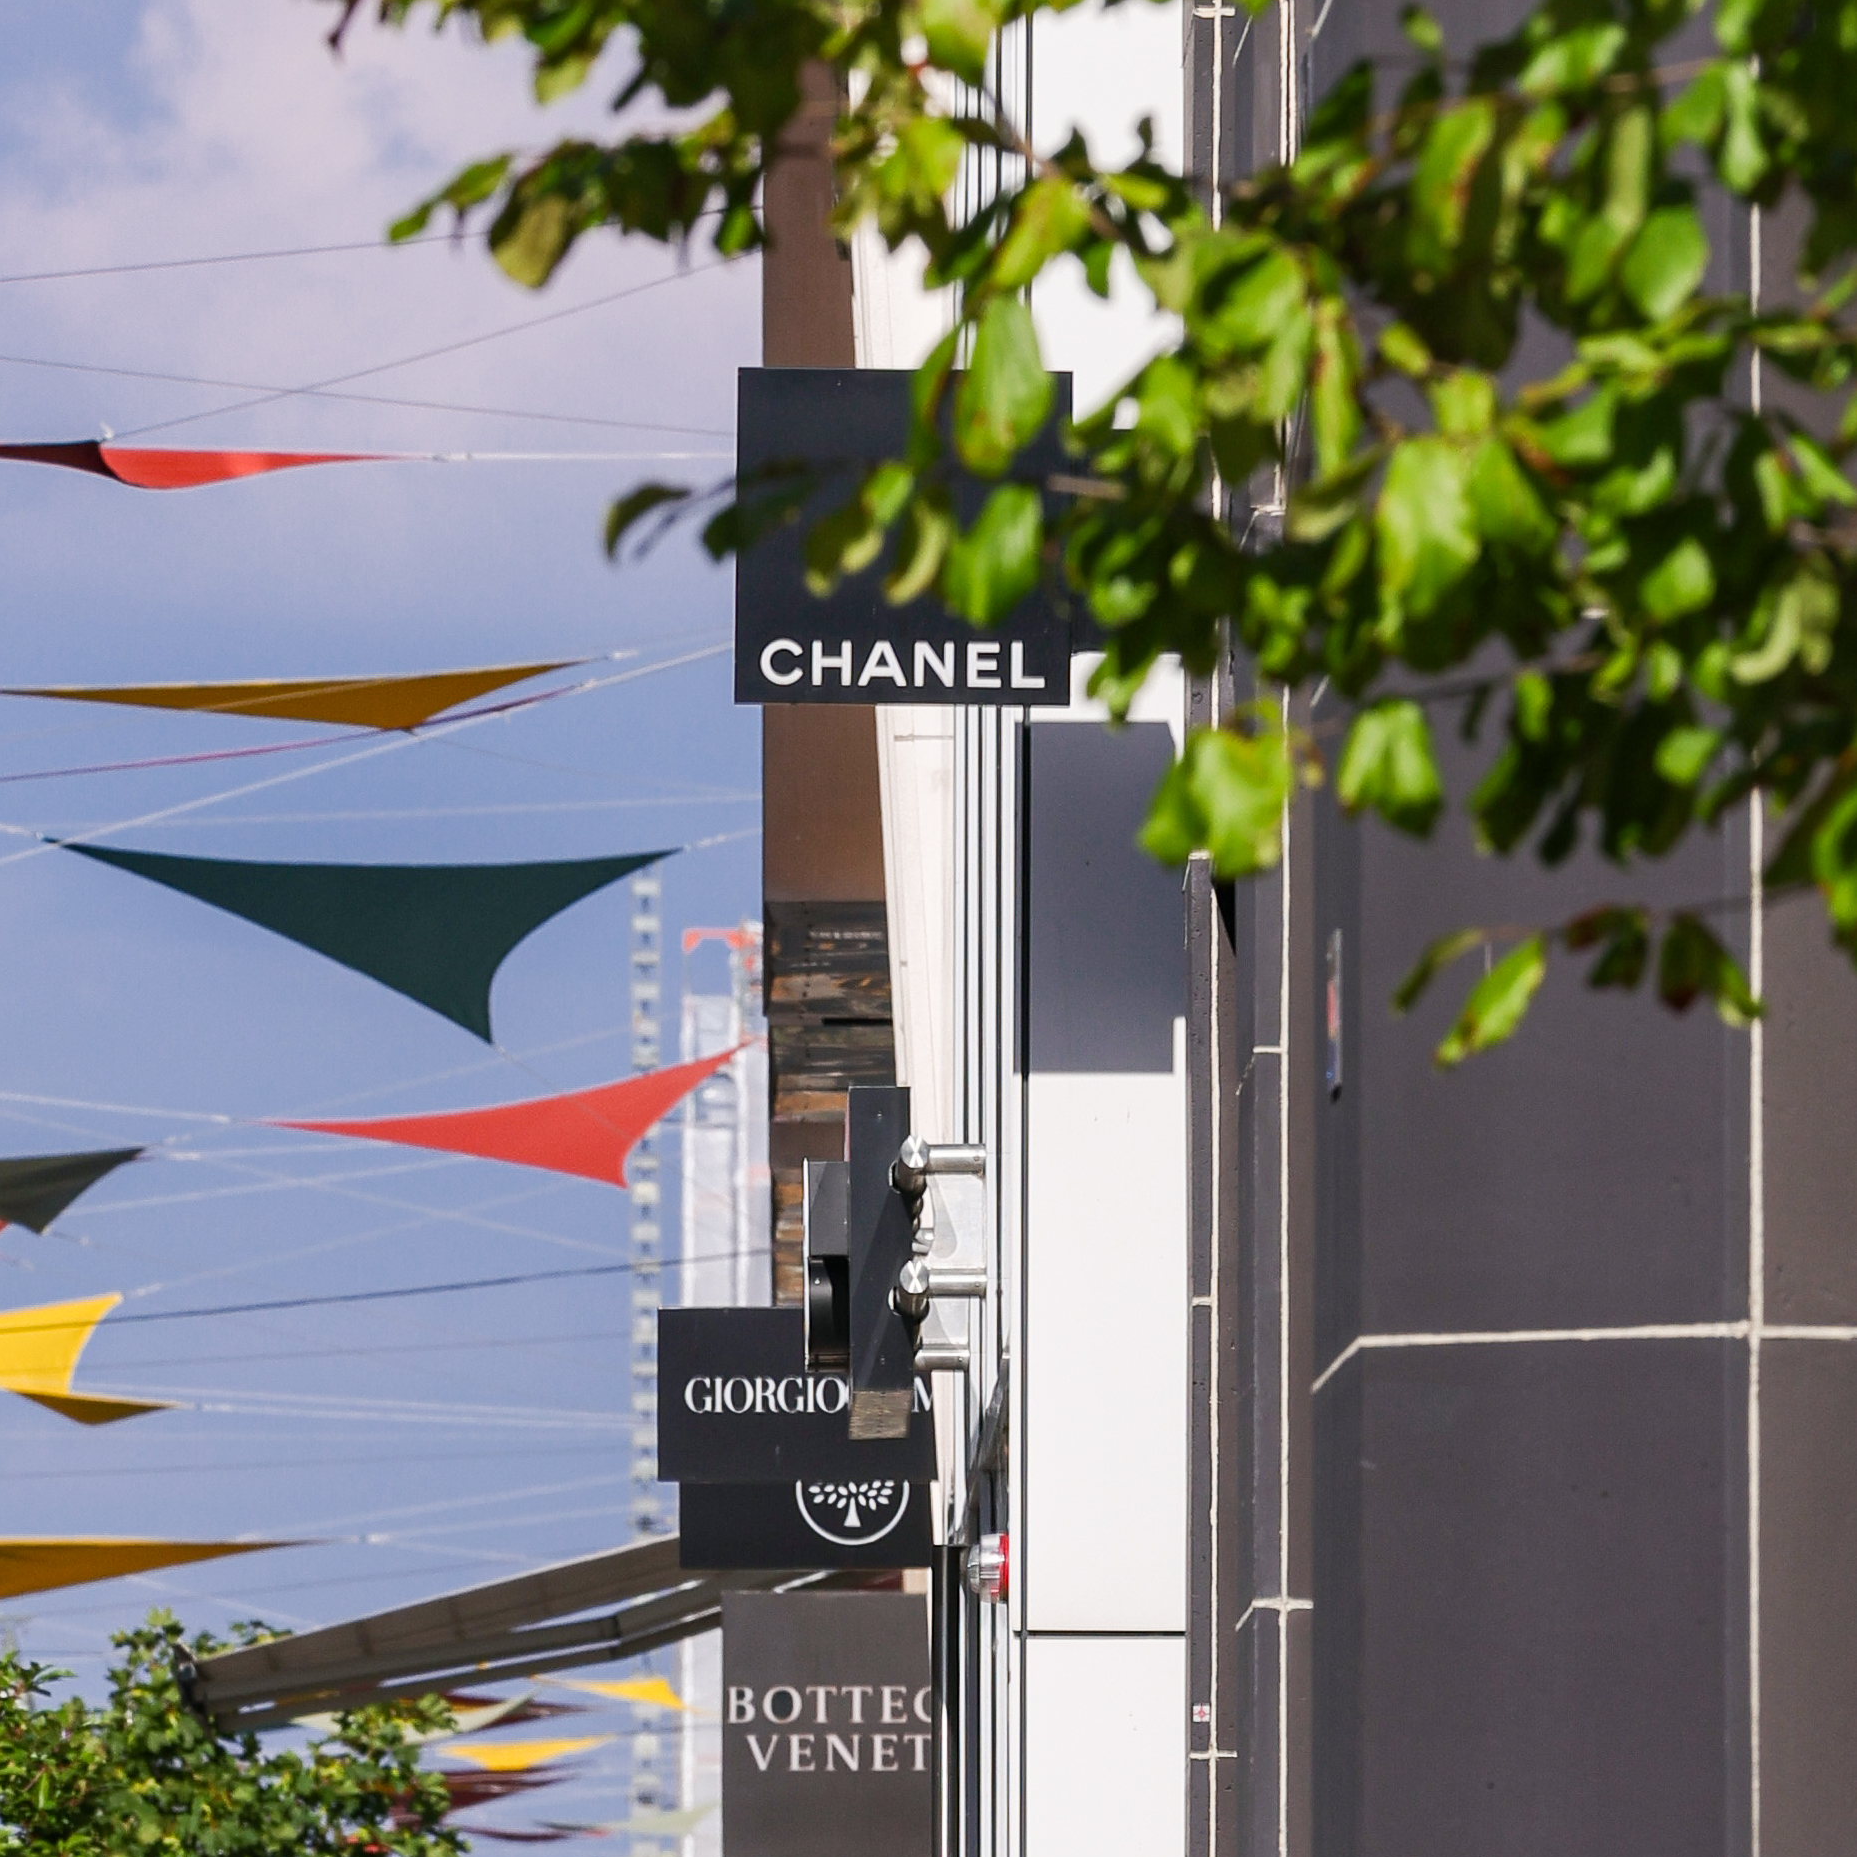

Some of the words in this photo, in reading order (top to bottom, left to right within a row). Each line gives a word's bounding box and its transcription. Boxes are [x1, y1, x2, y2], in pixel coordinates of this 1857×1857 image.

[759, 638, 1046, 689] CHANEL
[684, 1376, 847, 1414] GIORGIO
[746, 1733, 931, 1772] VENET
